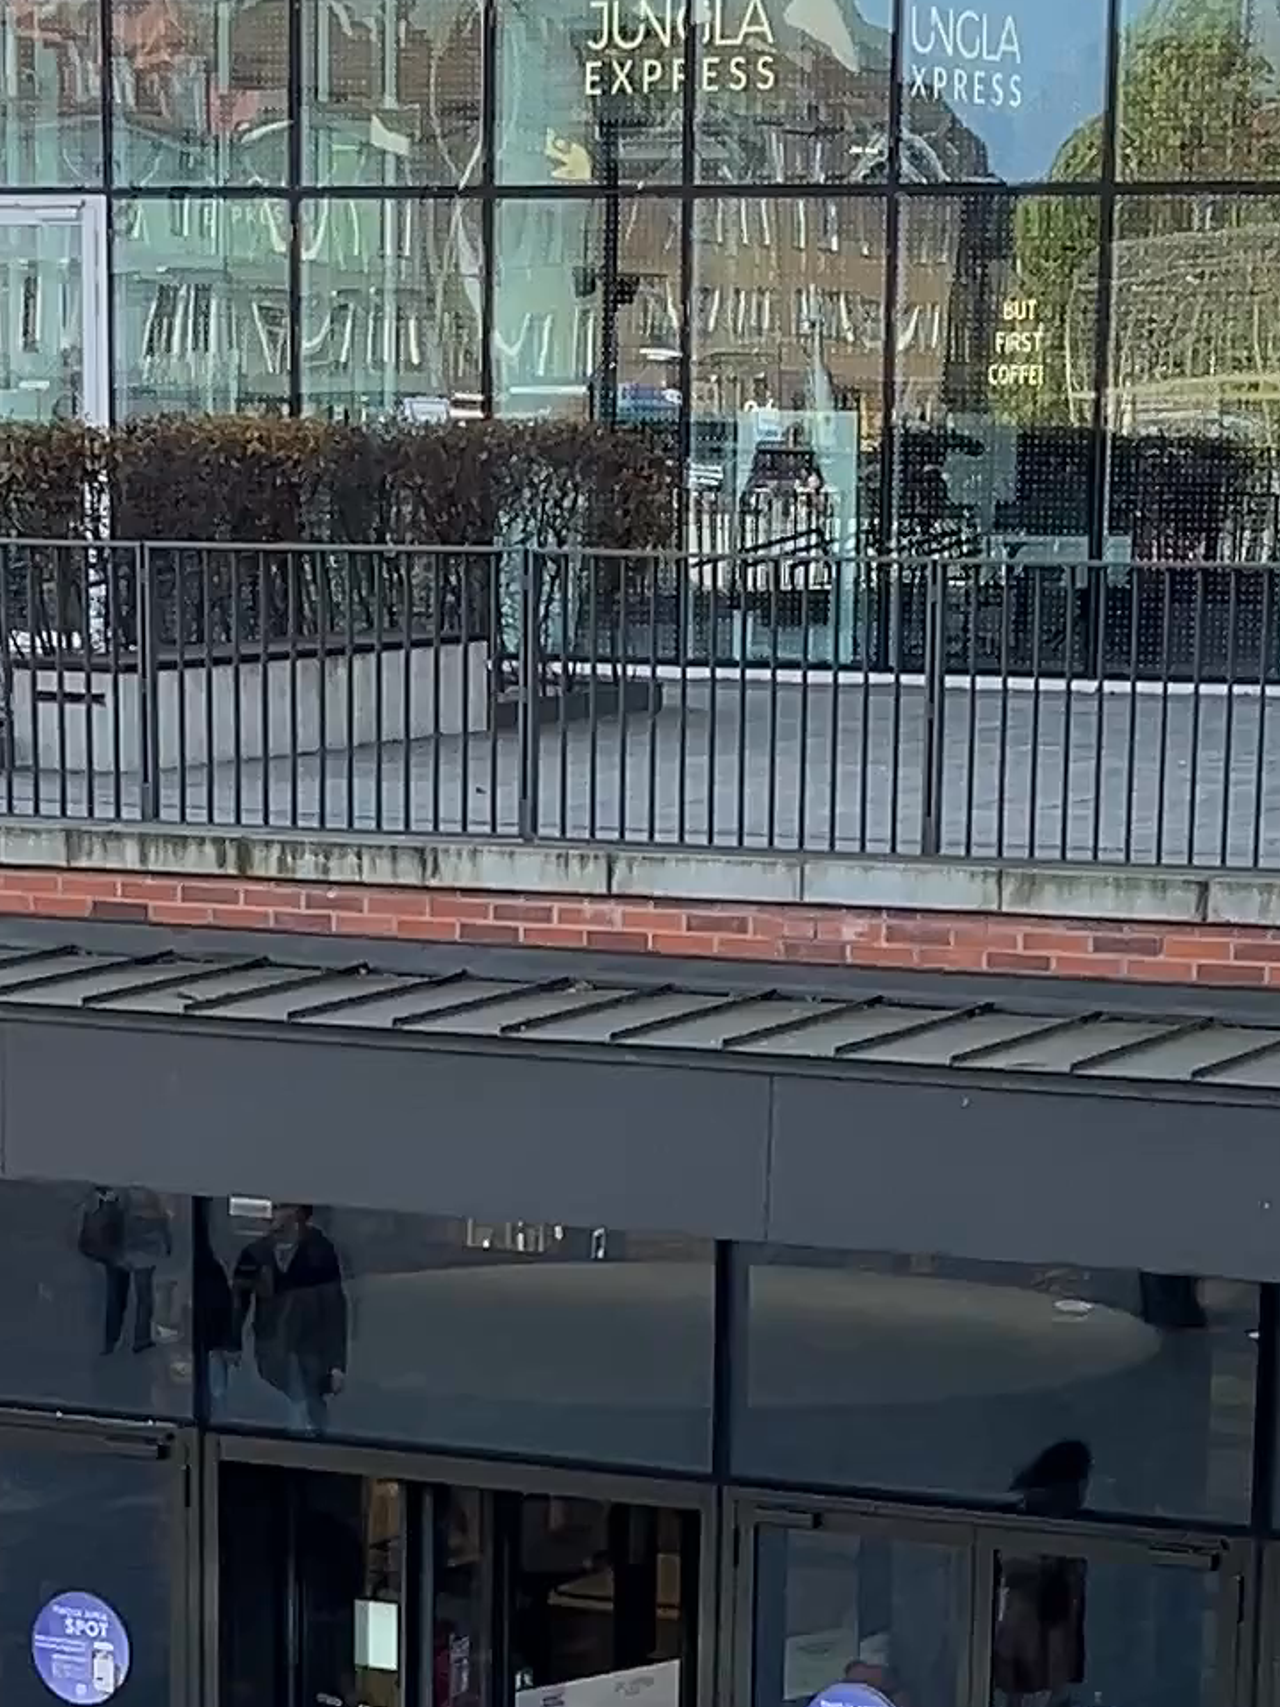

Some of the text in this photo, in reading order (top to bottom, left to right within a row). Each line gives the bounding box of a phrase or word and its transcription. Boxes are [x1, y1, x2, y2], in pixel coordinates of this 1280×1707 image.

[911, 6, 1021, 64] UNGLA
[910, 65, 1021, 108] XPRESS
[1003, 299, 1037, 320] BUT
[995, 331, 1043, 354] FIRST
[64, 1617, 109, 1637] SPOT
